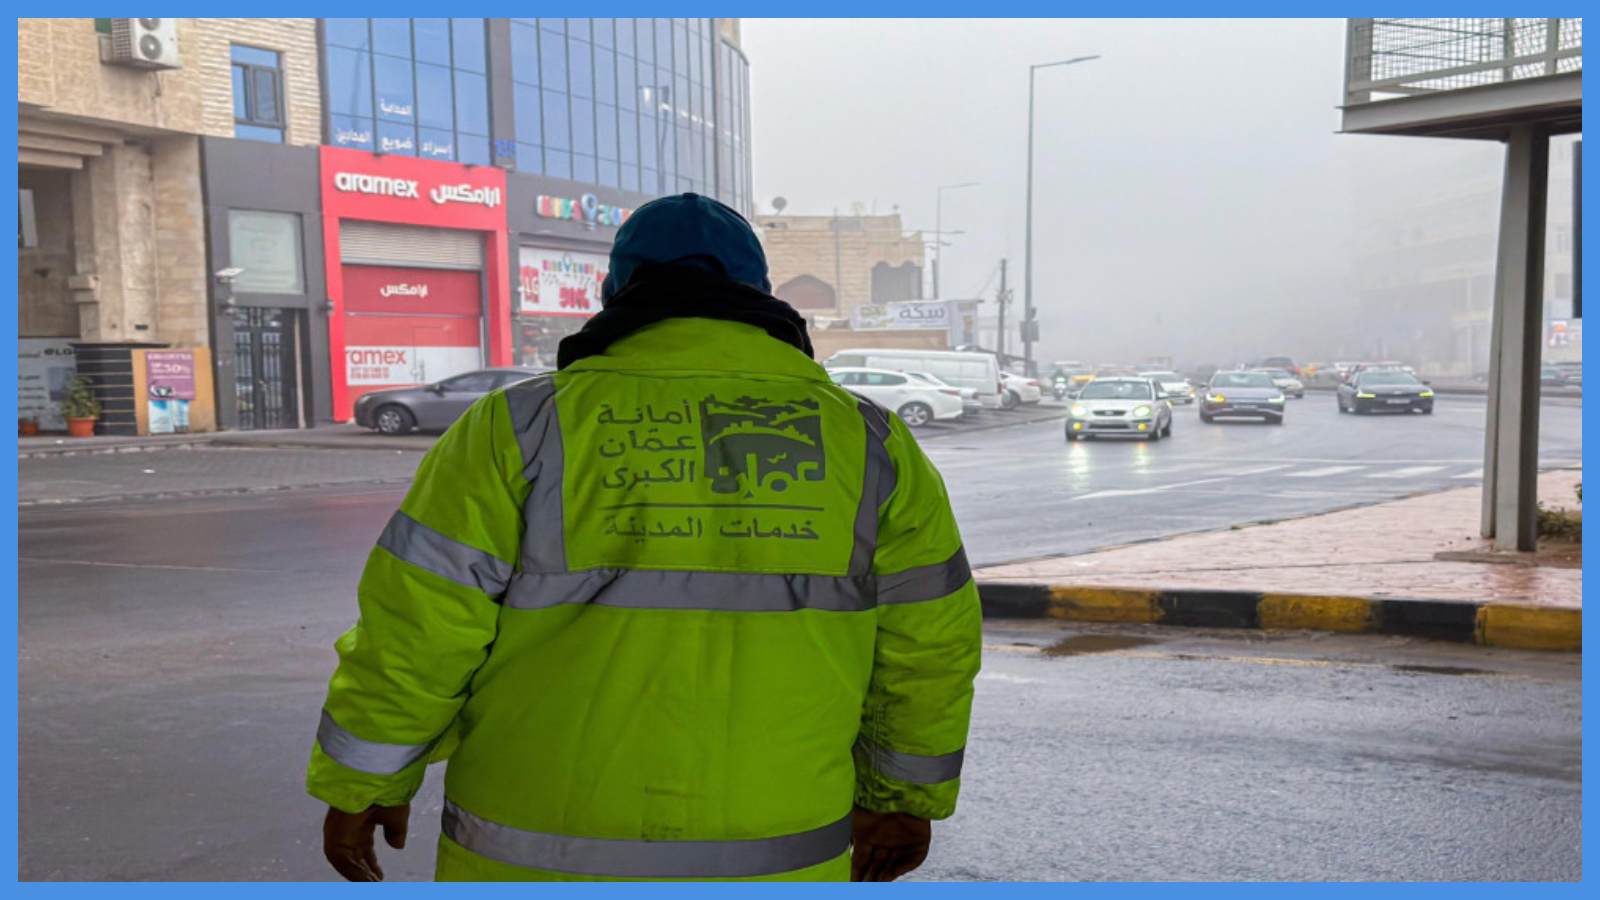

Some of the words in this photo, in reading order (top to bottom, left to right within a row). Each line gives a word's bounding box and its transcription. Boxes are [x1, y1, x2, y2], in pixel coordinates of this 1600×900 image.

[335, 172, 419, 198] aramex
[597, 400, 693, 425] أمانة
[602, 458, 695, 492] الكبرى
[604, 515, 703, 544] المدينة
[719, 518, 819, 540] خدمات
